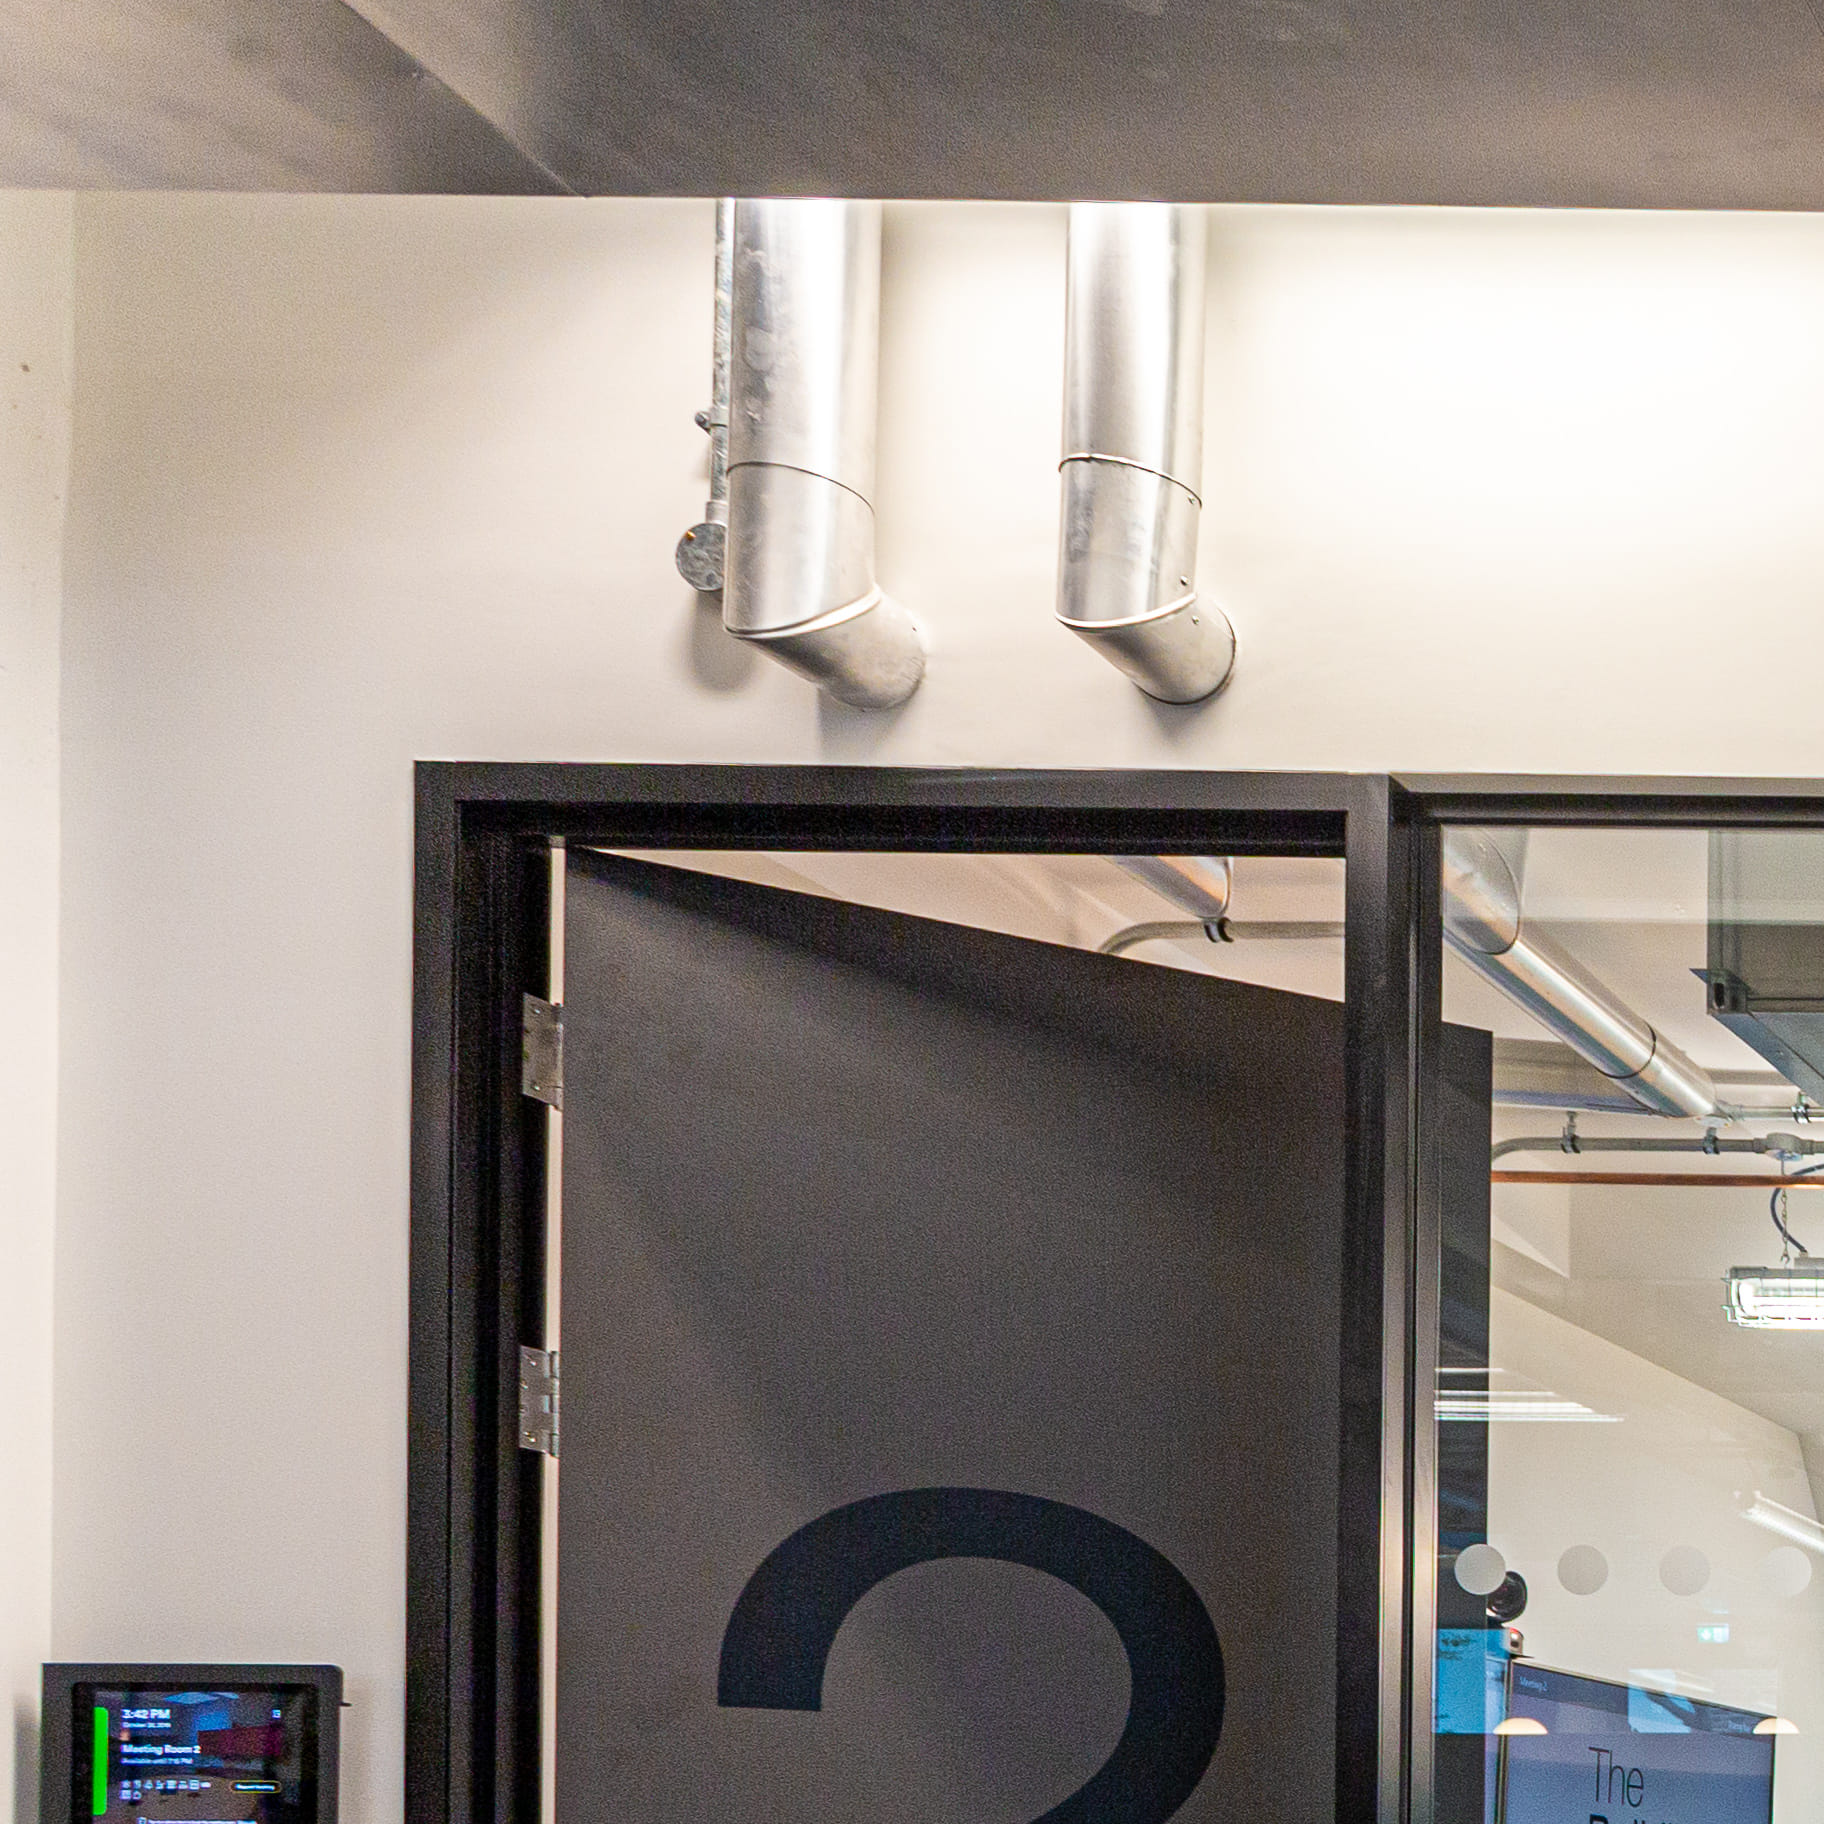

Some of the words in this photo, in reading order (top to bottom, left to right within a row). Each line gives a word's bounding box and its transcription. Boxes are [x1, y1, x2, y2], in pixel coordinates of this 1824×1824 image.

[150, 1709, 170, 1719] PM
[122, 1744, 163, 1755] Meeting
[164, 1744, 192, 1753] Room
[193, 1745, 201, 1754] 2
[1588, 1746, 1644, 1807] The
